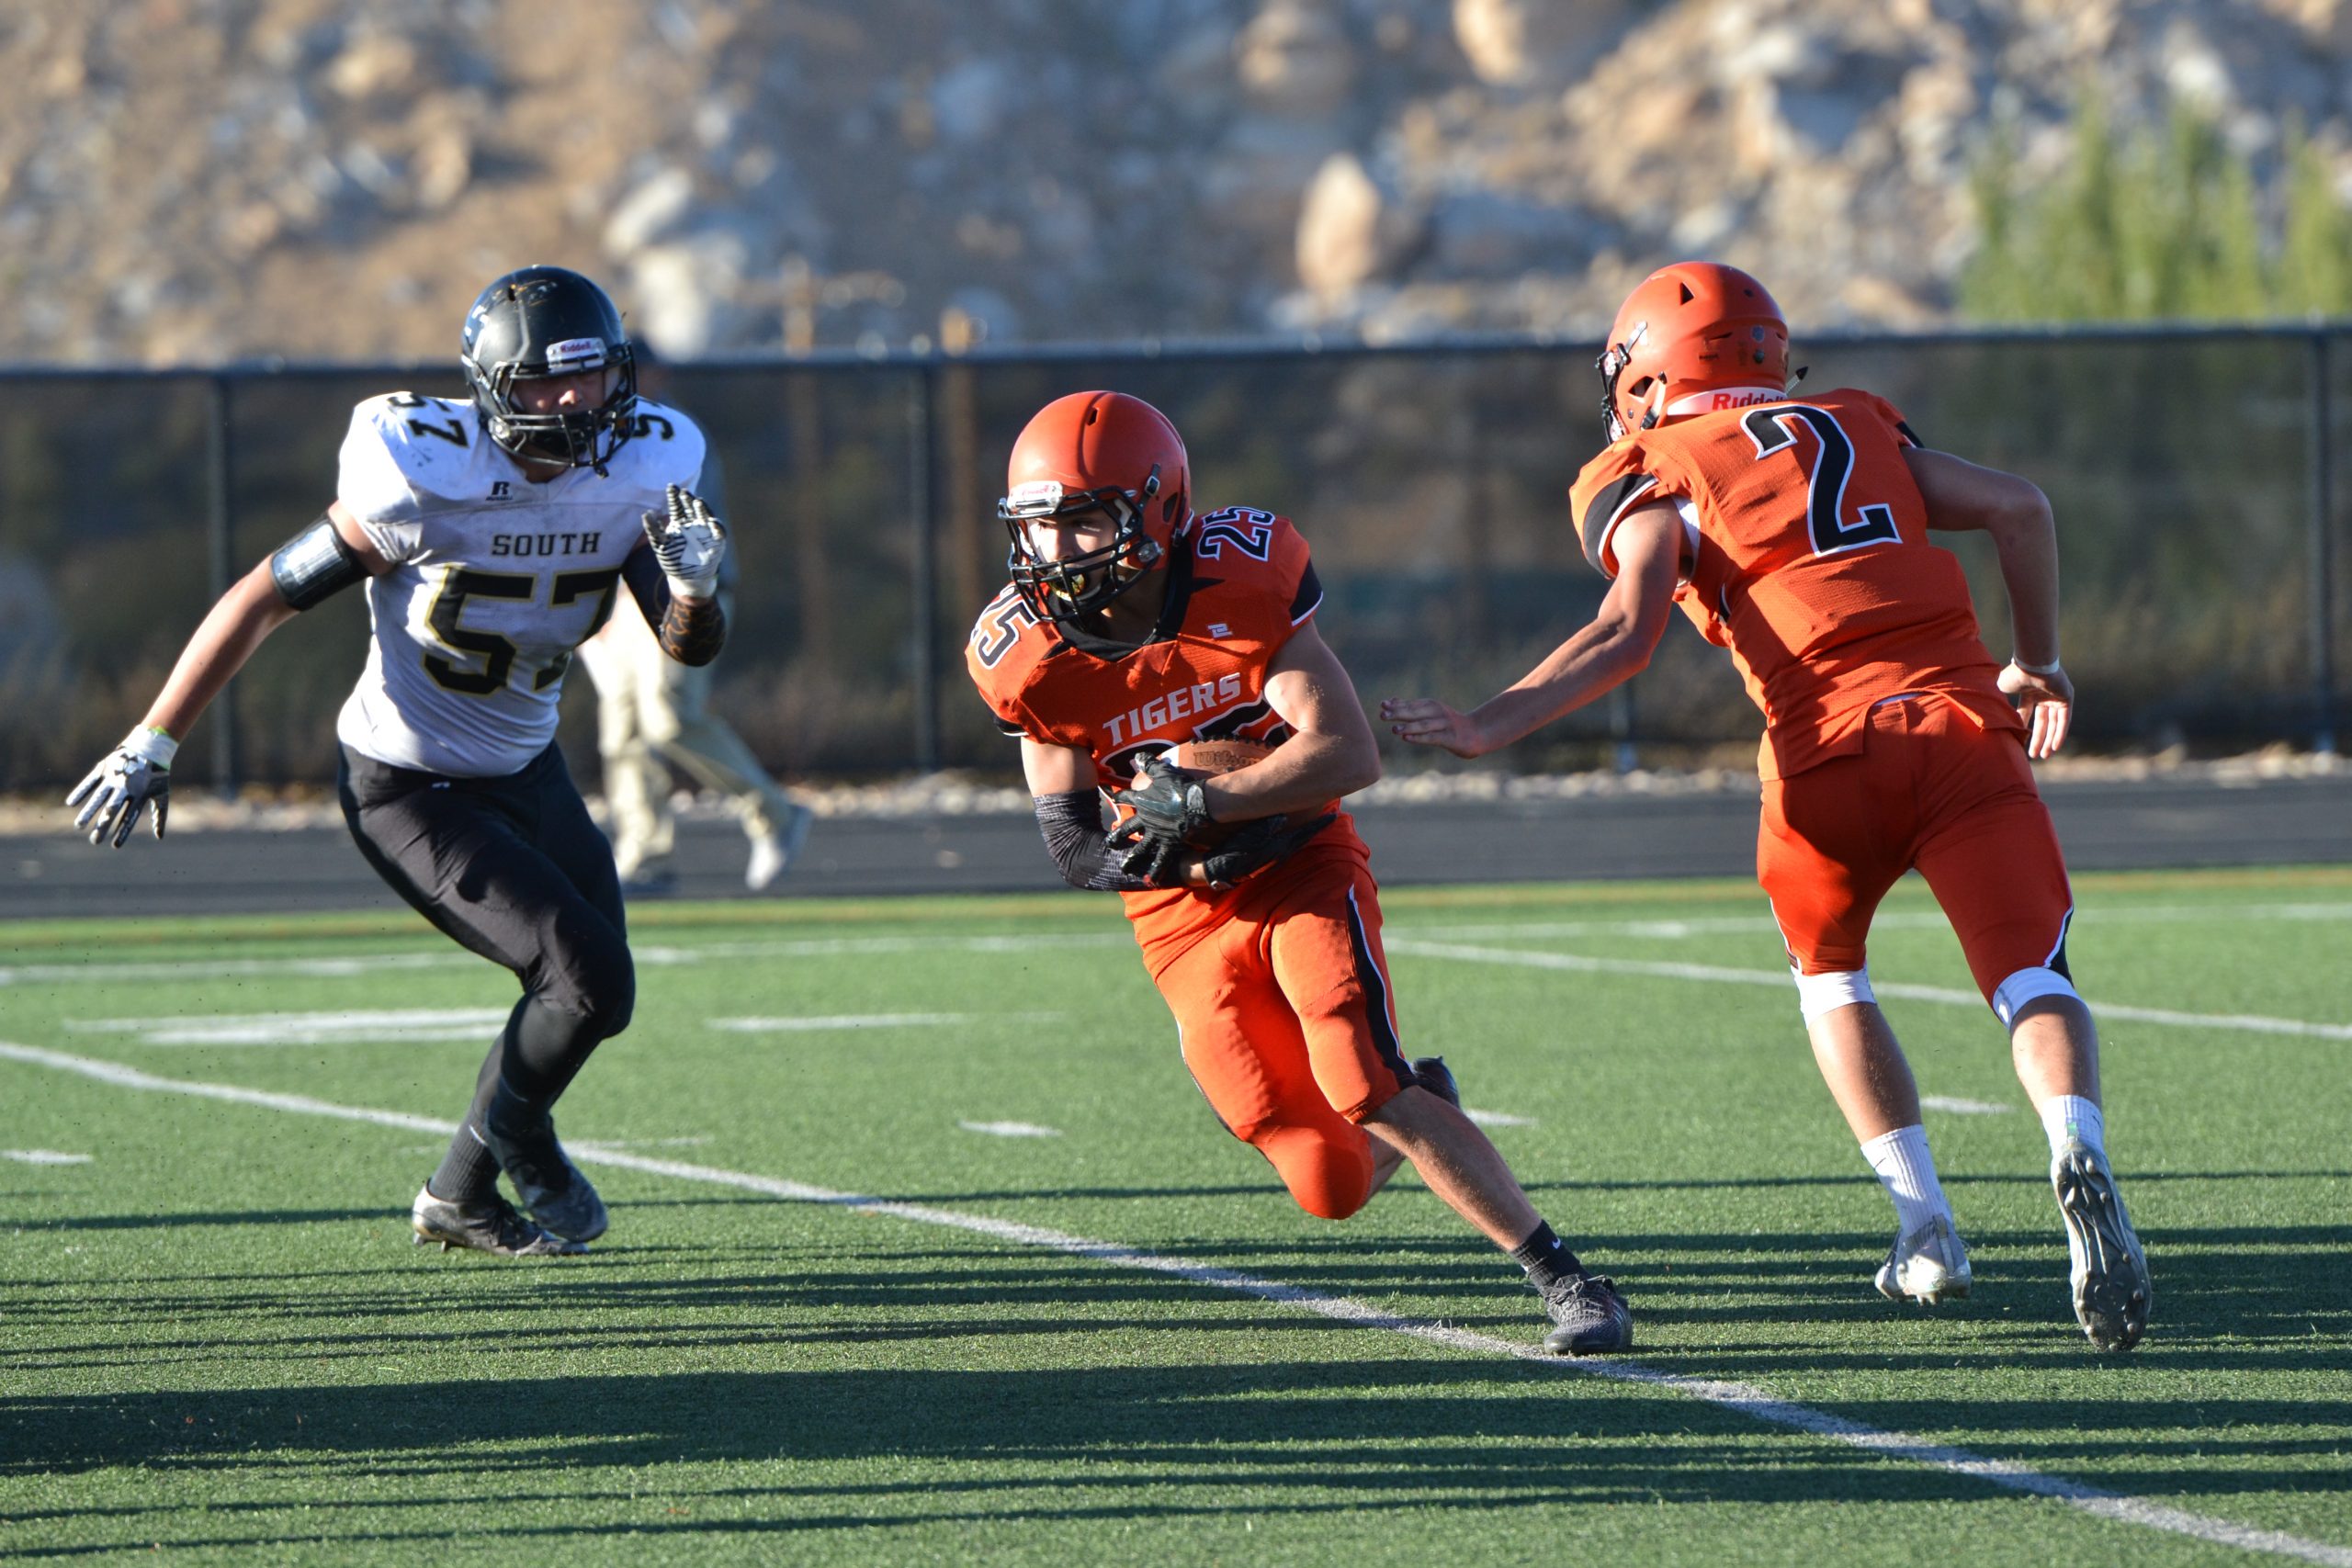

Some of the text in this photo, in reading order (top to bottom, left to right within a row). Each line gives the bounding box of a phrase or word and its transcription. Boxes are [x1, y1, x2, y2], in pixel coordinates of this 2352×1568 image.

[1712, 392, 1785, 411] Ridd
[1739, 403, 1904, 558] 2
[491, 531, 603, 557] SOUTH
[1197, 506, 1276, 562] 25
[420, 561, 628, 698] 57
[1102, 671, 1241, 747] TIGERS
